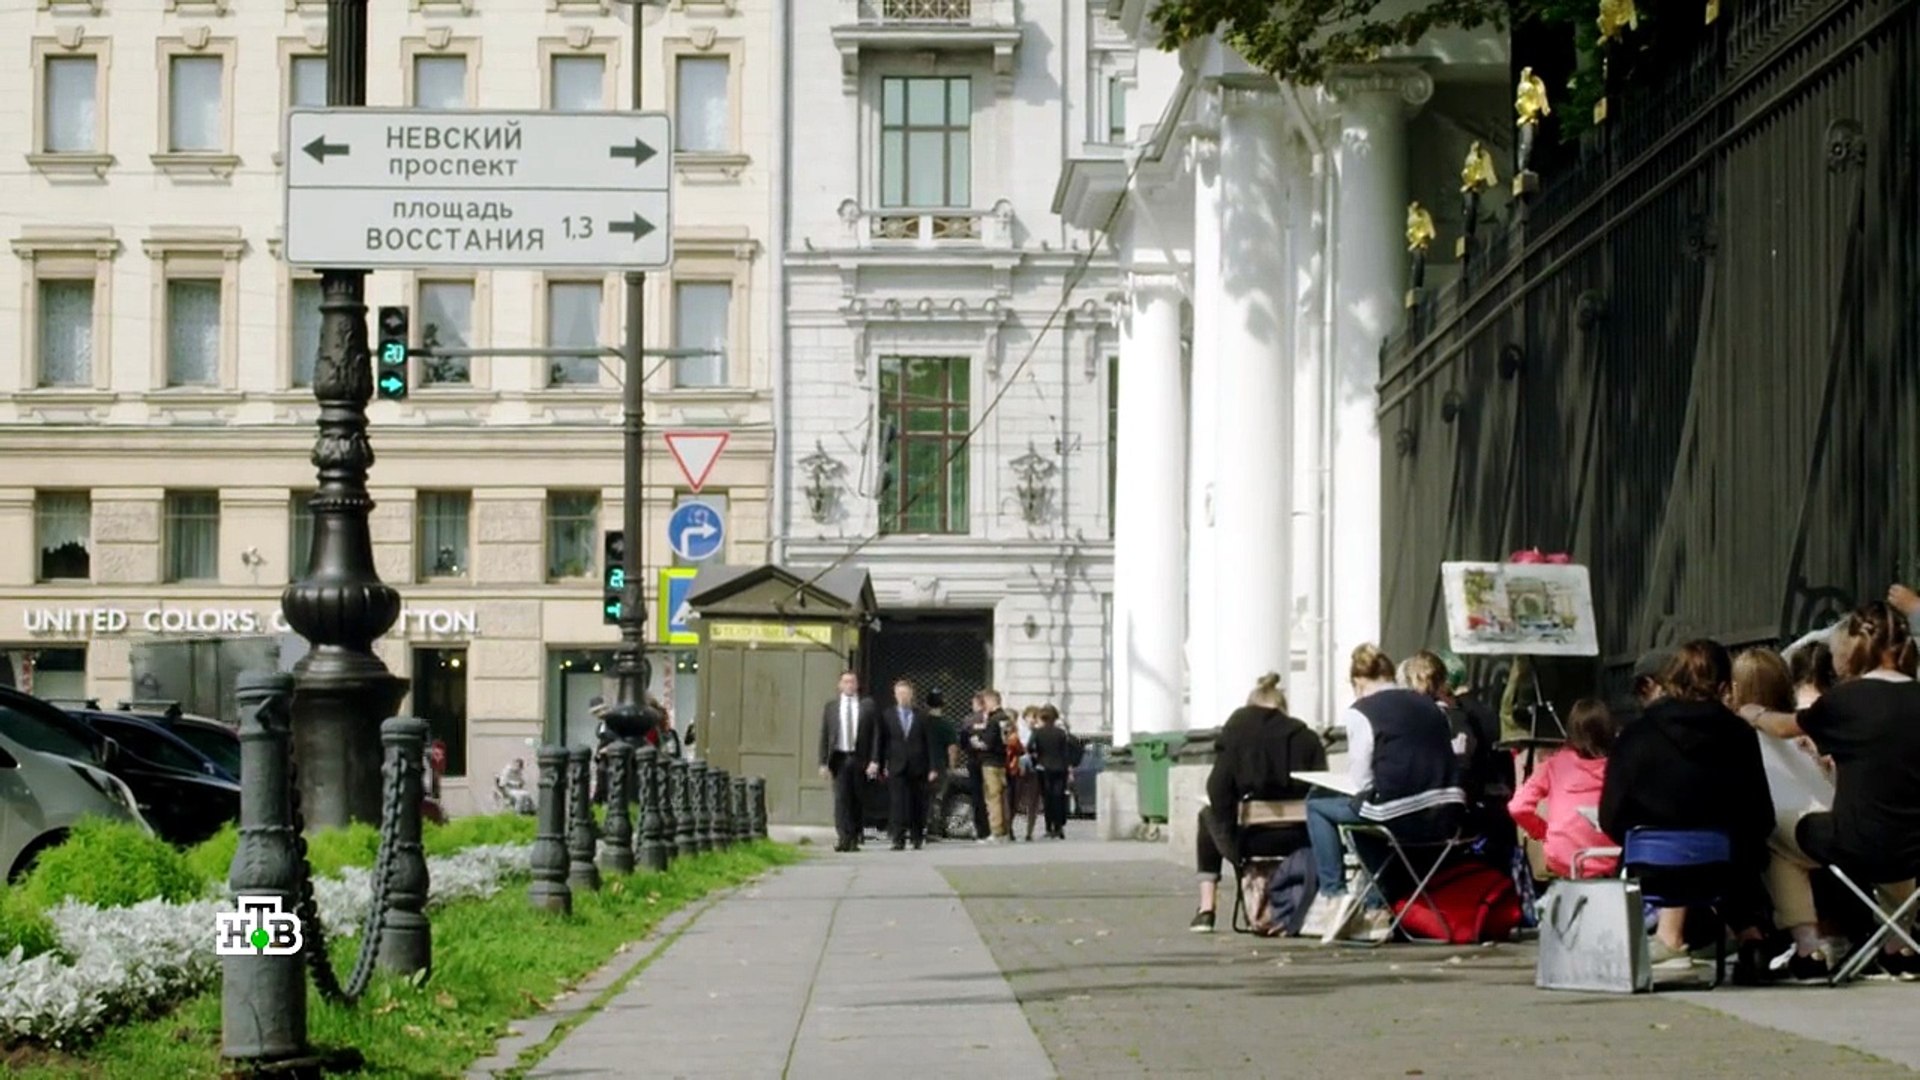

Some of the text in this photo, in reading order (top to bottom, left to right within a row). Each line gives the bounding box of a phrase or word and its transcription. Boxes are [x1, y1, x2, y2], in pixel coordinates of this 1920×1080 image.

[386, 121, 523, 150] НЕВСКИЙ
[389, 157, 518, 181] проспект
[392, 201, 513, 222] площадь
[365, 228, 544, 252] ВОССТАНИЯ
[383, 342, 405, 364] 20
[23, 608, 128, 632] UNITED
